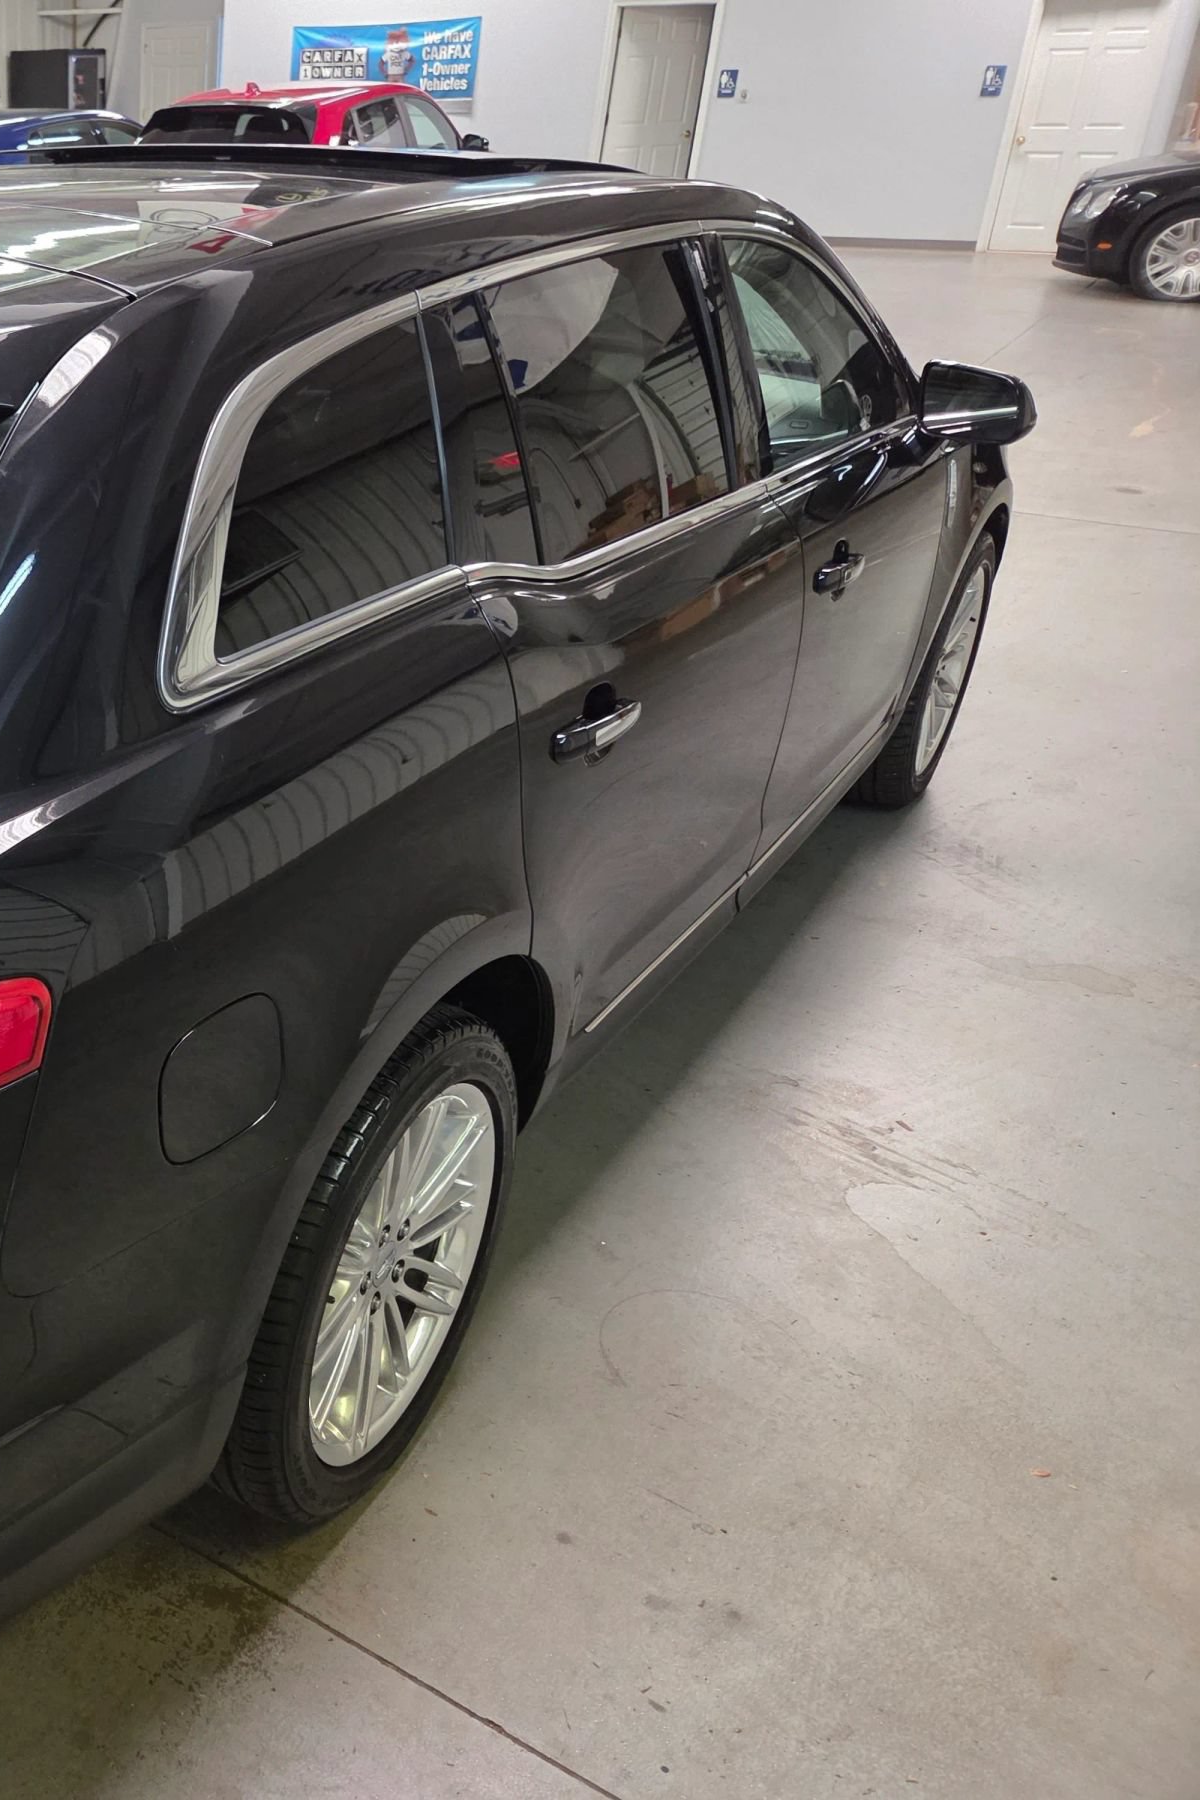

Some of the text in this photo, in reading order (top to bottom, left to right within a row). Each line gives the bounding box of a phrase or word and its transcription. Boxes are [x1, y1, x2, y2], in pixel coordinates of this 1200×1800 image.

[423, 30, 474, 44] We have
[301, 49, 366, 64] CARFAX
[422, 44, 472, 60] CARFAX
[422, 62, 471, 76] 1-Owner
[420, 77, 468, 91] Vehicles
